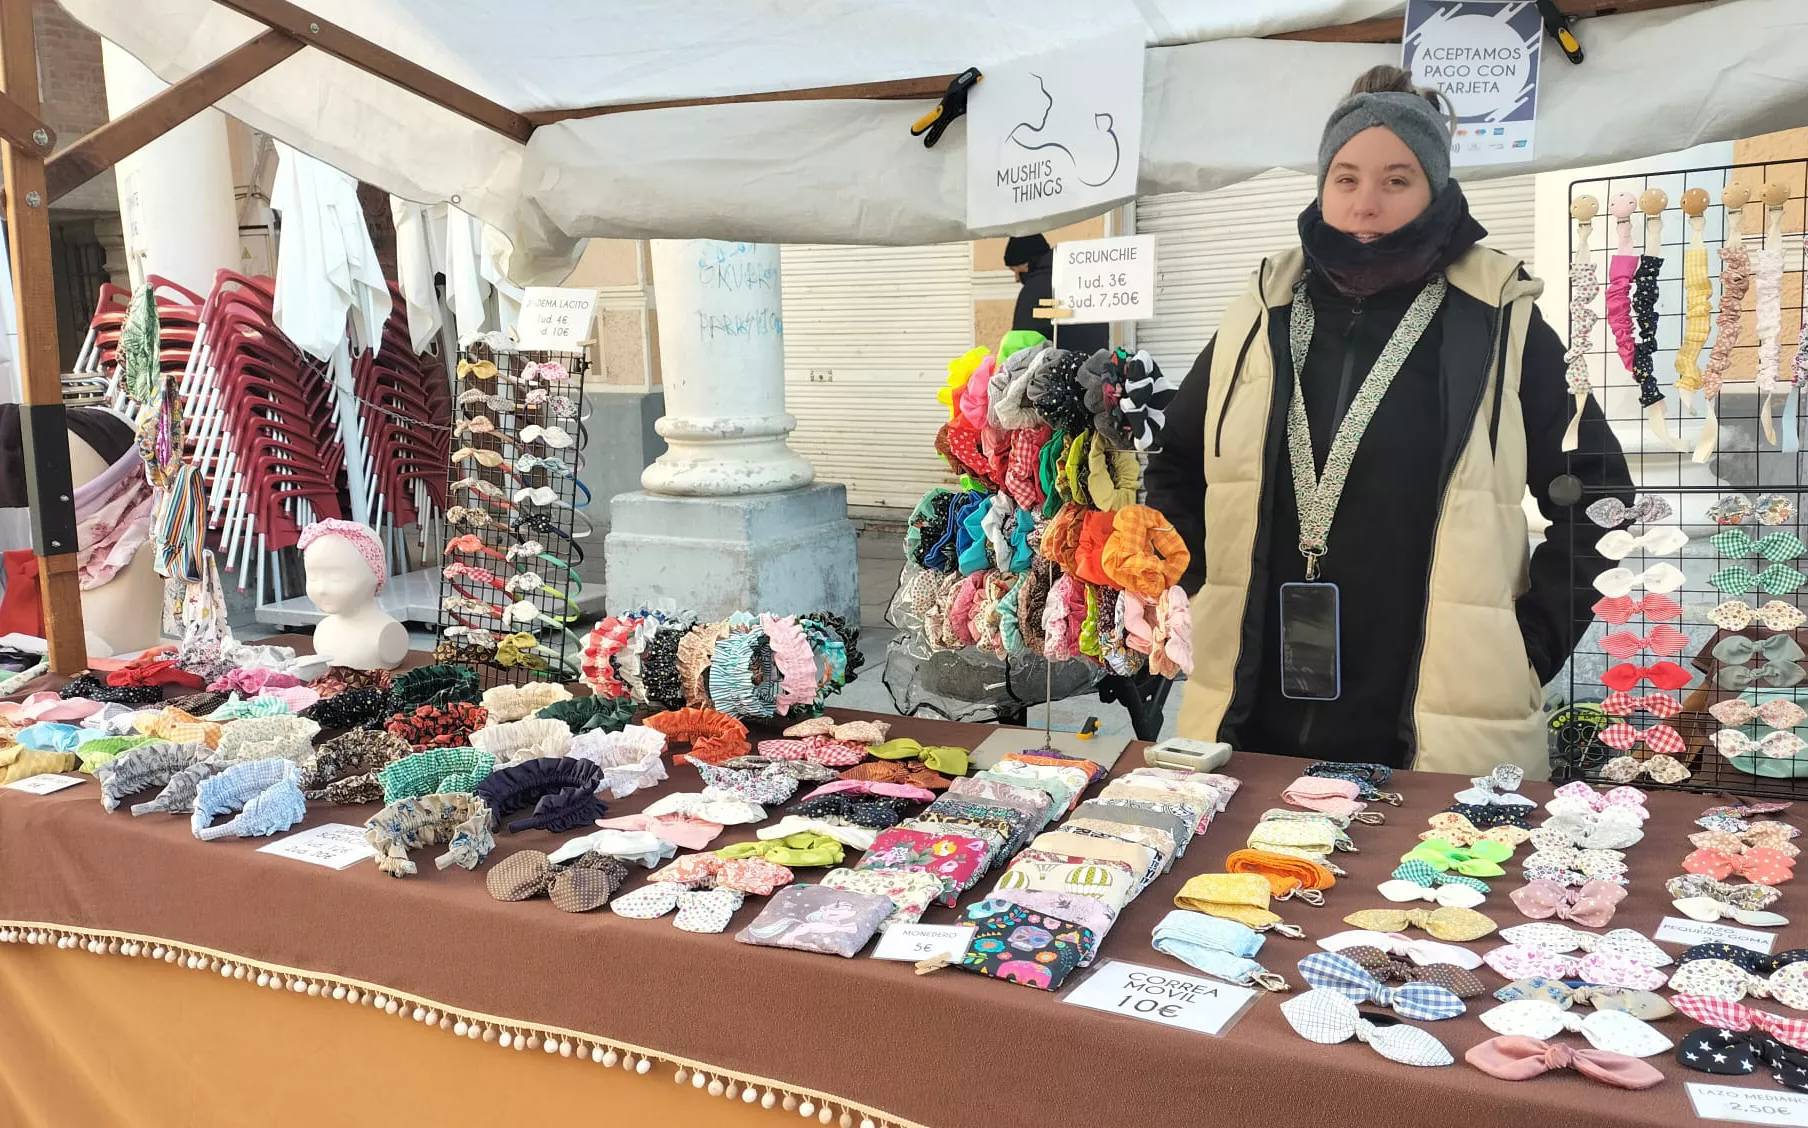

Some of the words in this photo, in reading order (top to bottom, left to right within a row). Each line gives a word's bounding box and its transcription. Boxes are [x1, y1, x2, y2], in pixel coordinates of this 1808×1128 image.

[1422, 47, 1521, 61] ACEPTAMOS
[1424, 65, 1471, 77] PAGO
[1477, 64, 1516, 77] CON
[1437, 81, 1500, 94] TARJETA
[996, 159, 1053, 187] MUSHI'S
[1012, 177, 1063, 204] THINGS
[1068, 247, 1137, 265] SCRUNCHIE
[1109, 273, 1127, 288] 3€
[560, 299, 589, 310] LACITO
[1068, 293, 1095, 309] 3ud.
[1099, 291, 1140, 309] 7,50€
[553, 327, 570, 337] 10€
[902, 929, 957, 939] MONEDERO
[1699, 925, 1735, 934] LAZO
[1727, 934, 1770, 945] GOMA
[912, 943, 933, 953] 5€
[1127, 971, 1219, 999] CORREA
[1122, 981, 1198, 1004] MOVIL
[1117, 994, 1184, 1019] 10€
[1698, 1088, 1740, 1098] LAZO
[1729, 1102, 1792, 1115] 2.50€
